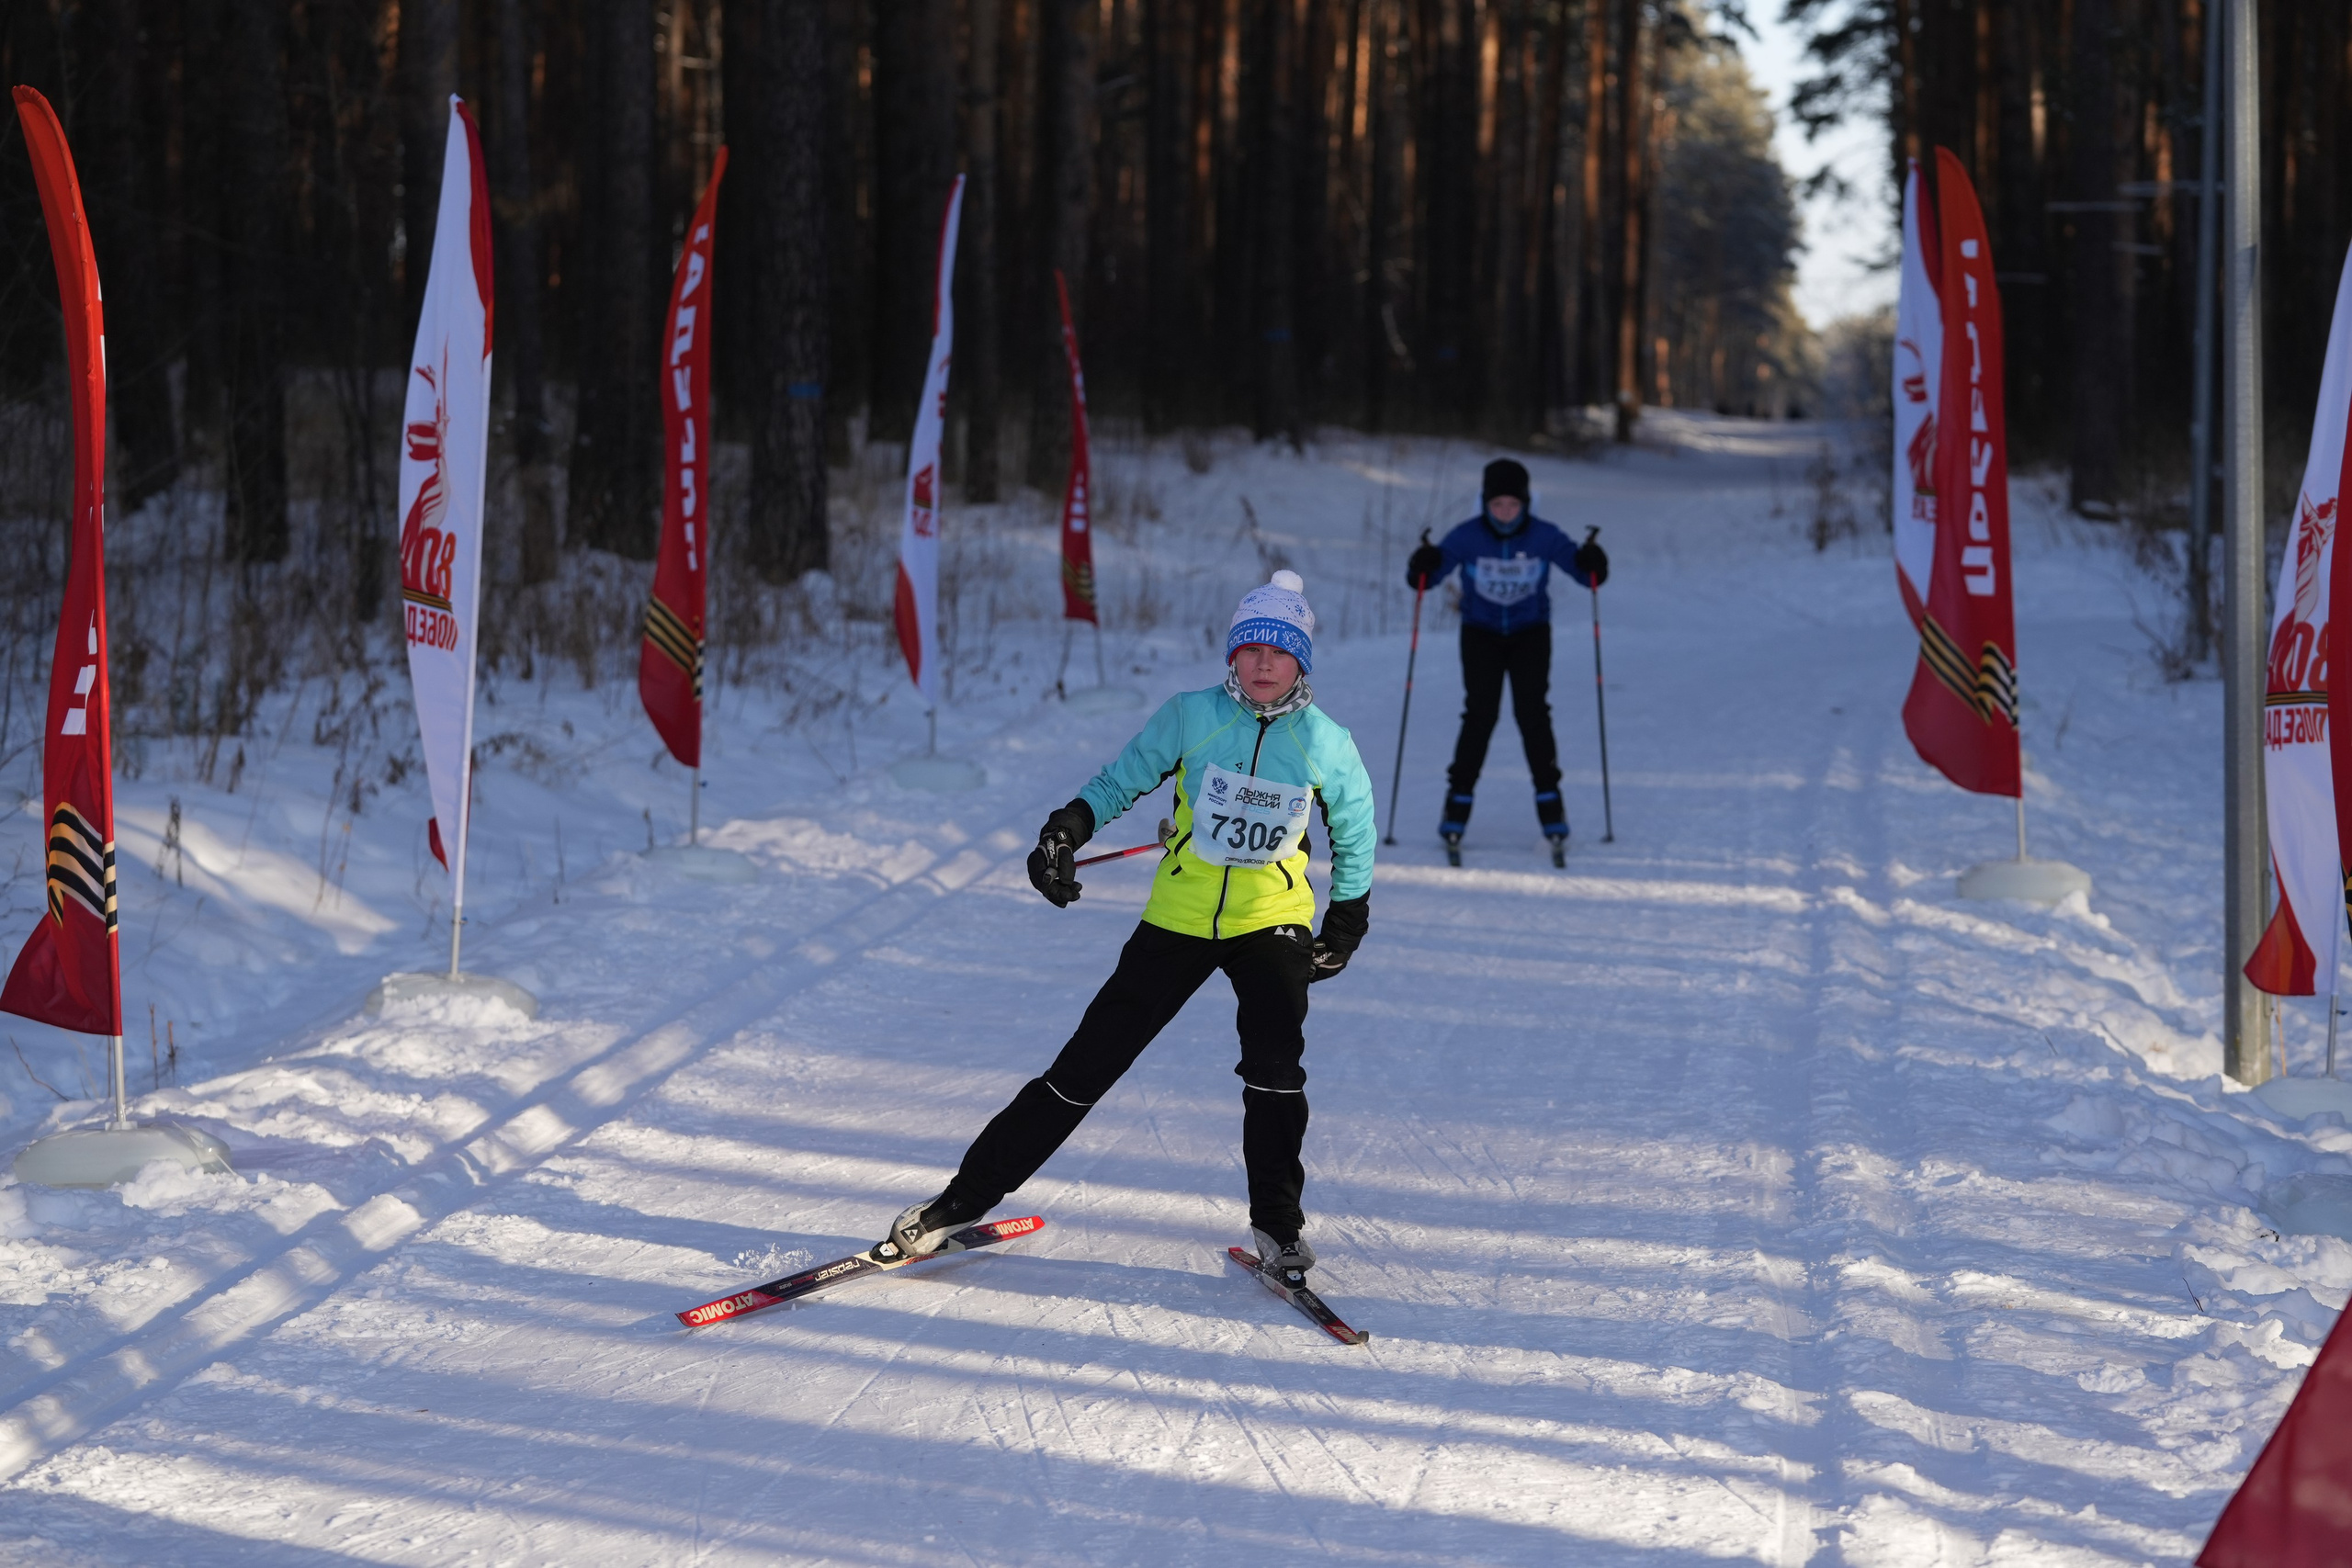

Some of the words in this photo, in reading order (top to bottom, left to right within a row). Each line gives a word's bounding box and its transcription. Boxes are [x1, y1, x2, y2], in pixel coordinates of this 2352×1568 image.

[1208, 797, 1224, 807] РОССИИ
[1235, 794, 1281, 809] РОССИИ
[1238, 786, 1281, 802] ЛЫЖНЯ
[1241, 804, 1271, 815] 2025
[1211, 813, 1288, 852] 7306
[989, 1217, 1035, 1237] ATOMIC
[689, 1292, 753, 1324] ATOMIC
